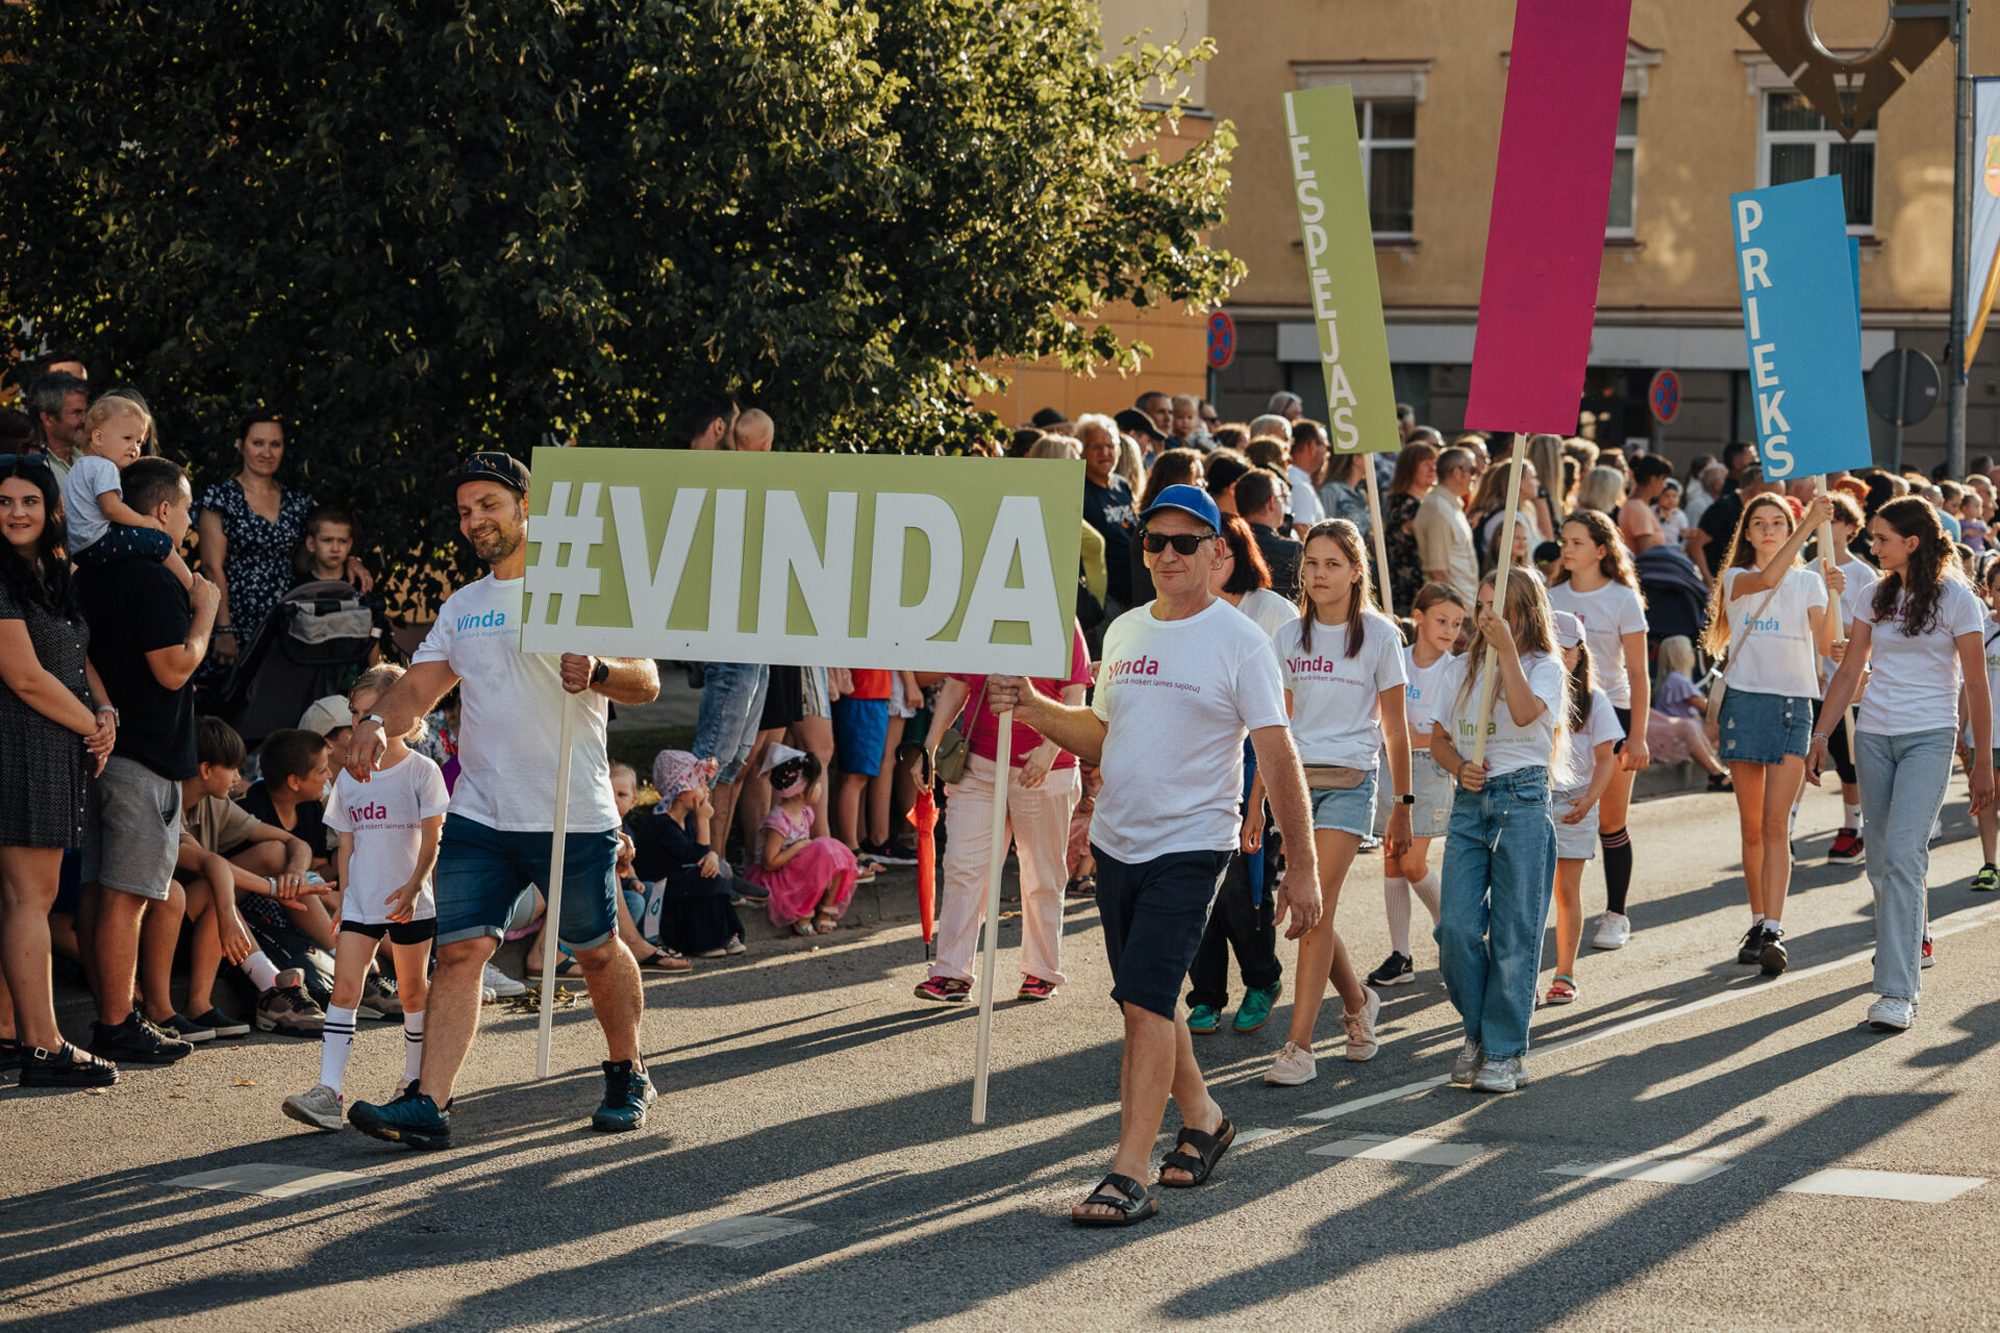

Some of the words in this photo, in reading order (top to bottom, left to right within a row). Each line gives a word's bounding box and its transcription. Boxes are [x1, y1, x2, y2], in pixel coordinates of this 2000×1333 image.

[1284, 92, 1359, 450] IESPĒJAS
[1737, 199, 1795, 478] PRIEKS
[523, 480, 1066, 646] #VINDA
[457, 610, 506, 632] Vinda
[1108, 655, 1159, 680] Vinda
[1286, 655, 1334, 674] Vinda
